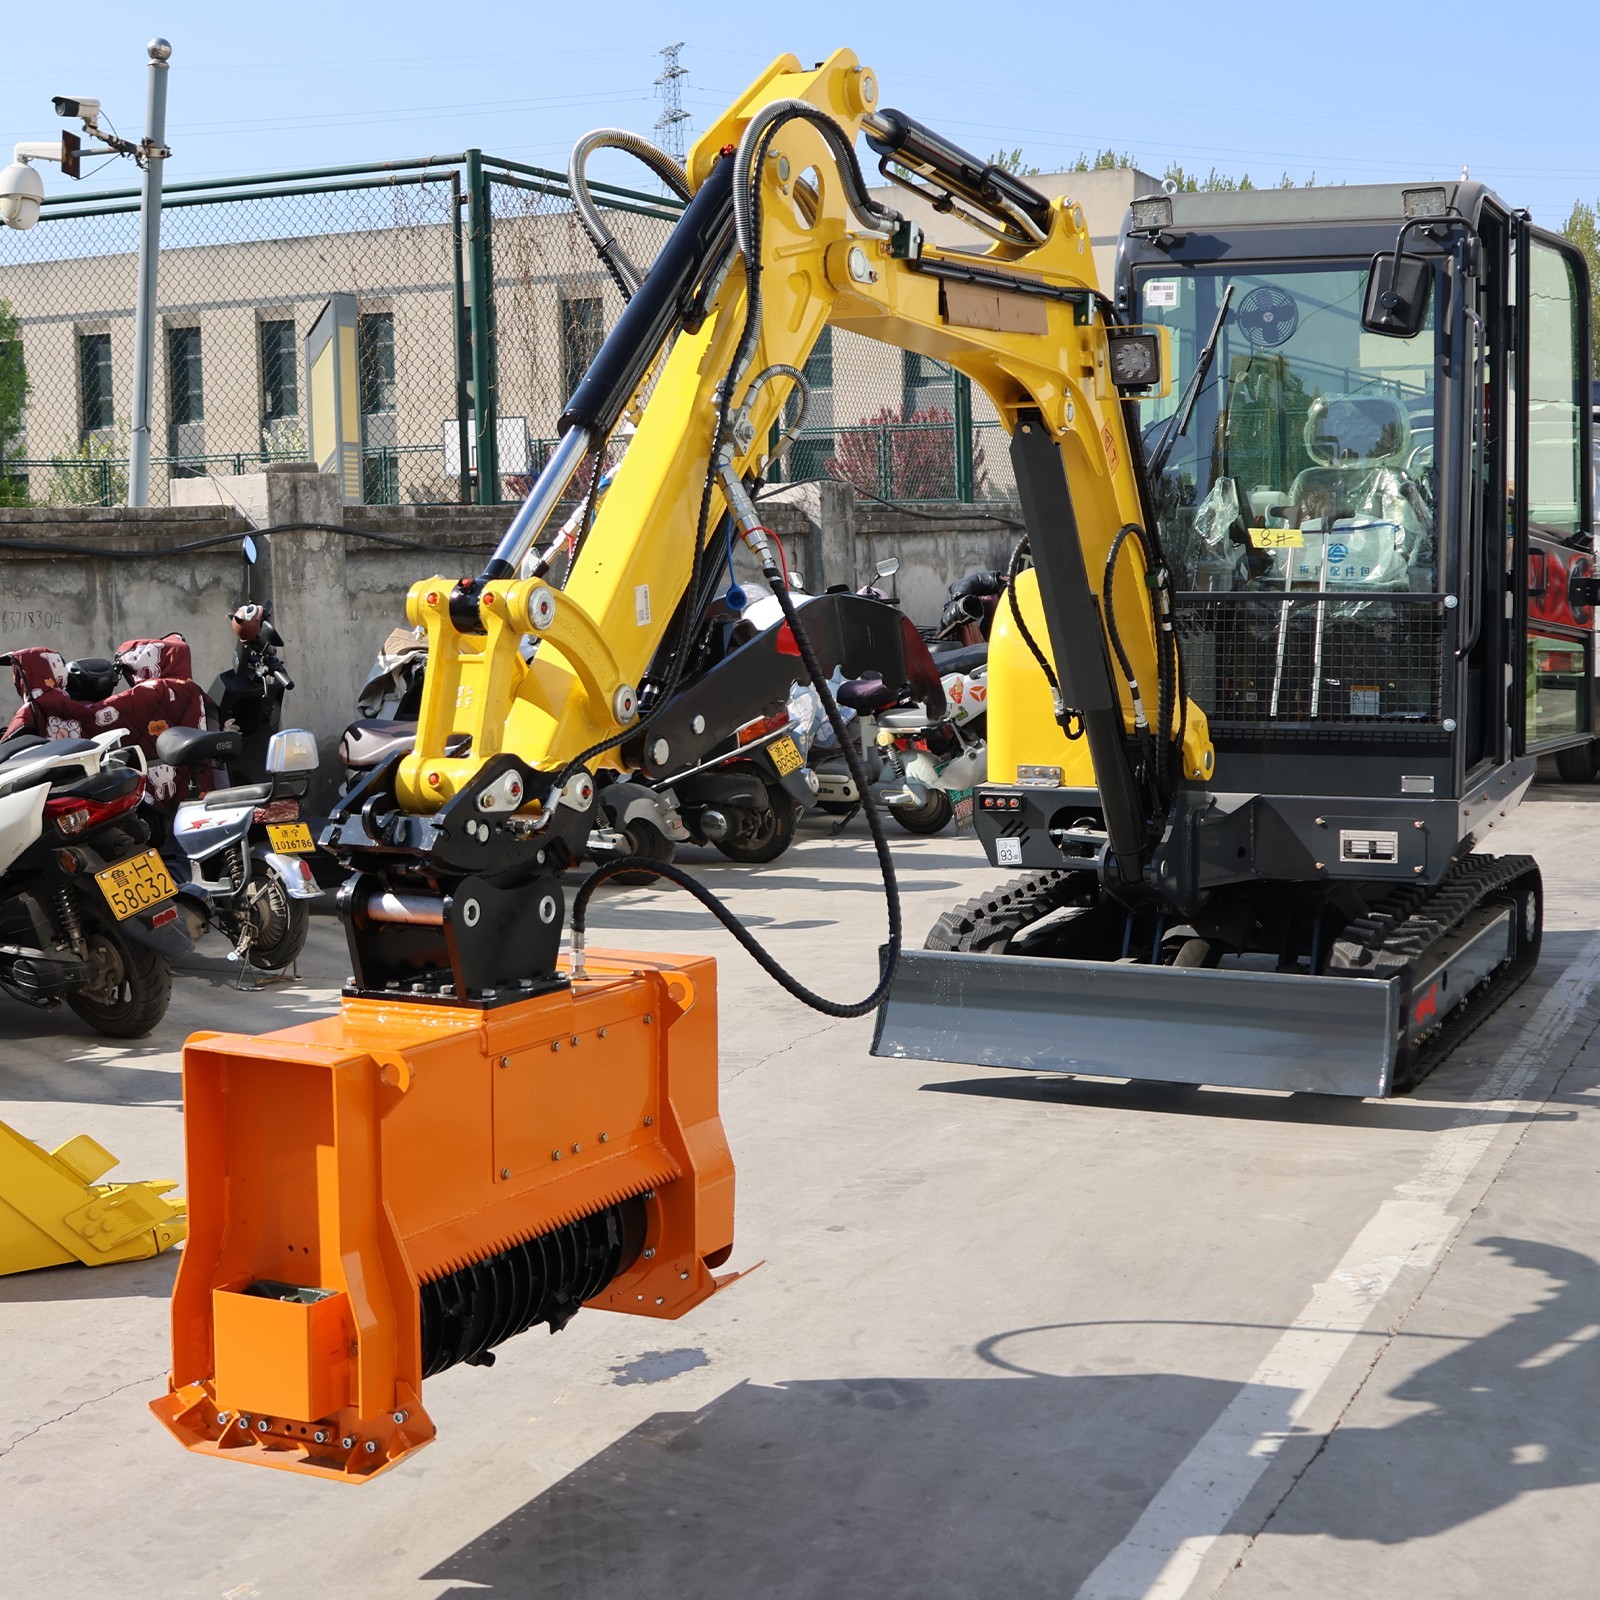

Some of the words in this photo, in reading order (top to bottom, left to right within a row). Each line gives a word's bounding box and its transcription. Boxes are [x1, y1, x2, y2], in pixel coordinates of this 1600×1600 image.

[1260, 528, 1294, 547] 8#
[776, 749, 802, 775] RR559
[275, 839, 313, 850] 1016786
[1000, 849, 1013, 861] 93
[111, 872, 173, 914] 58C32
